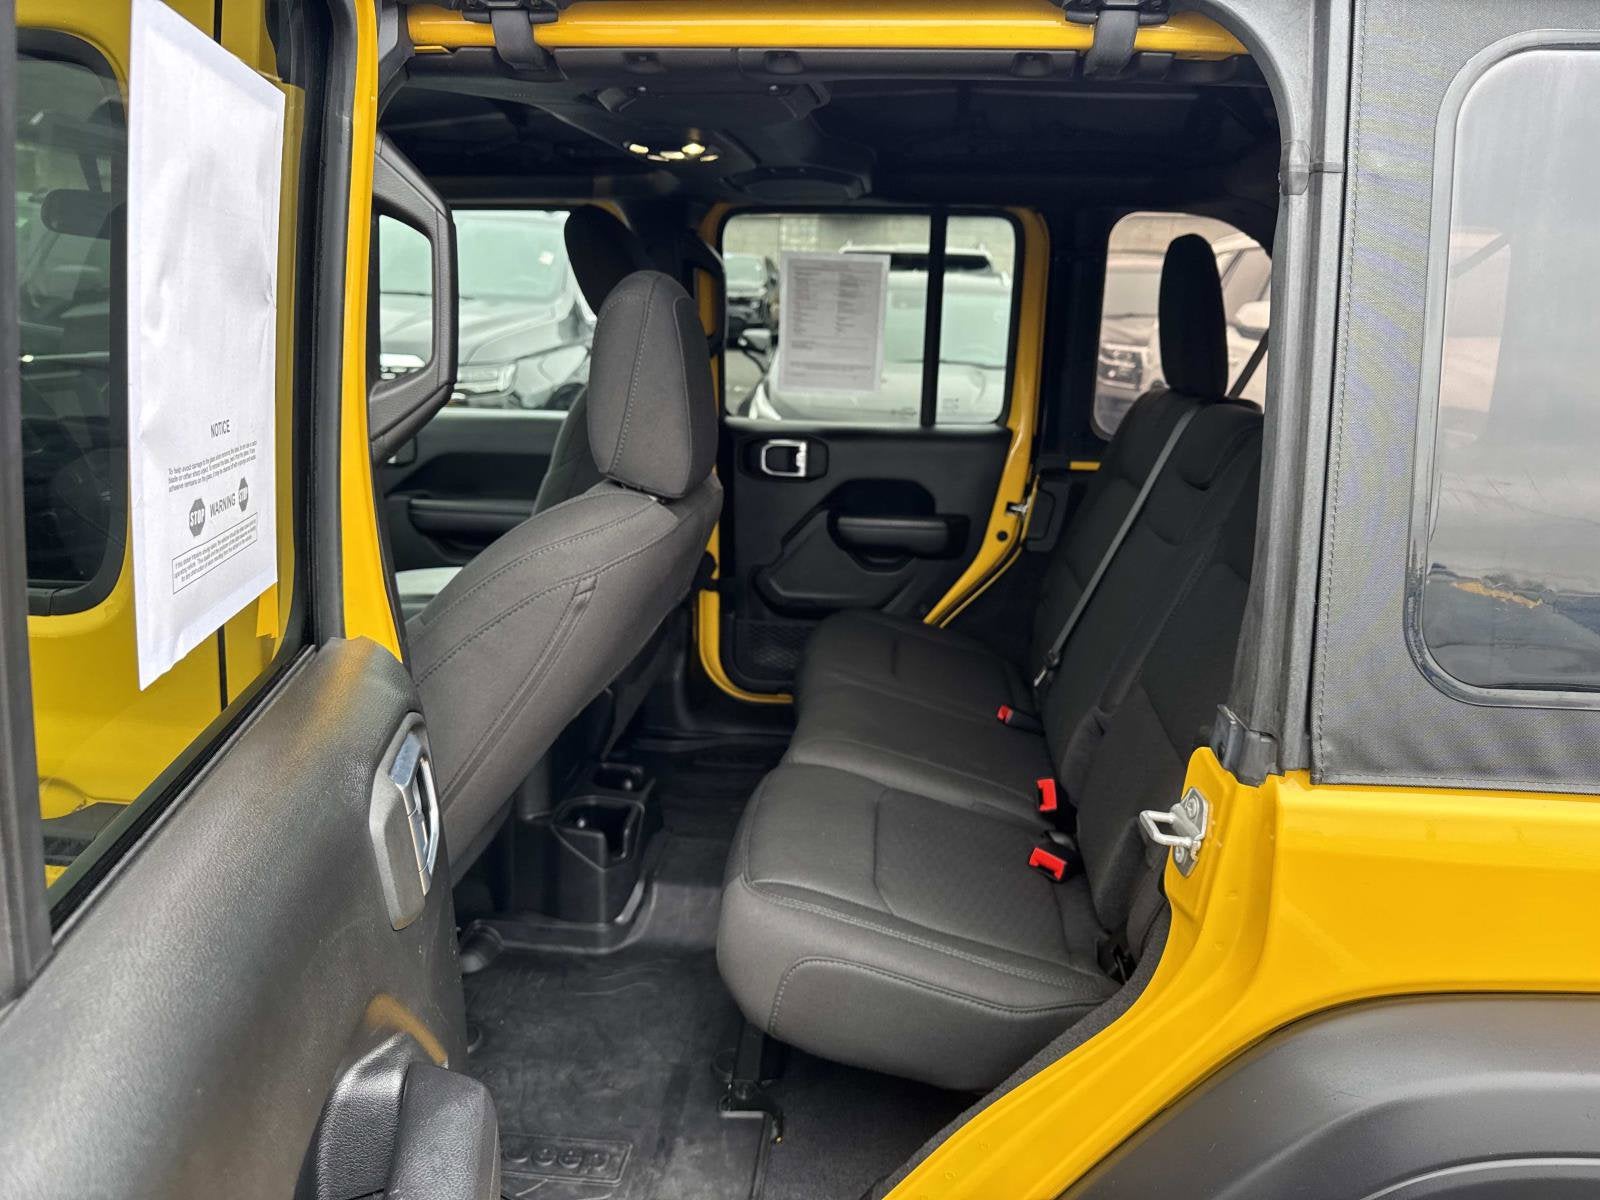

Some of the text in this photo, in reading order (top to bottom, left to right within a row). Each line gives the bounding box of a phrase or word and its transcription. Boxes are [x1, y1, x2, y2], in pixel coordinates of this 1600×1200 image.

[210, 419, 230, 438] NOTICE
[210, 492, 236, 518] WARNING
[190, 508, 205, 527] STOP
